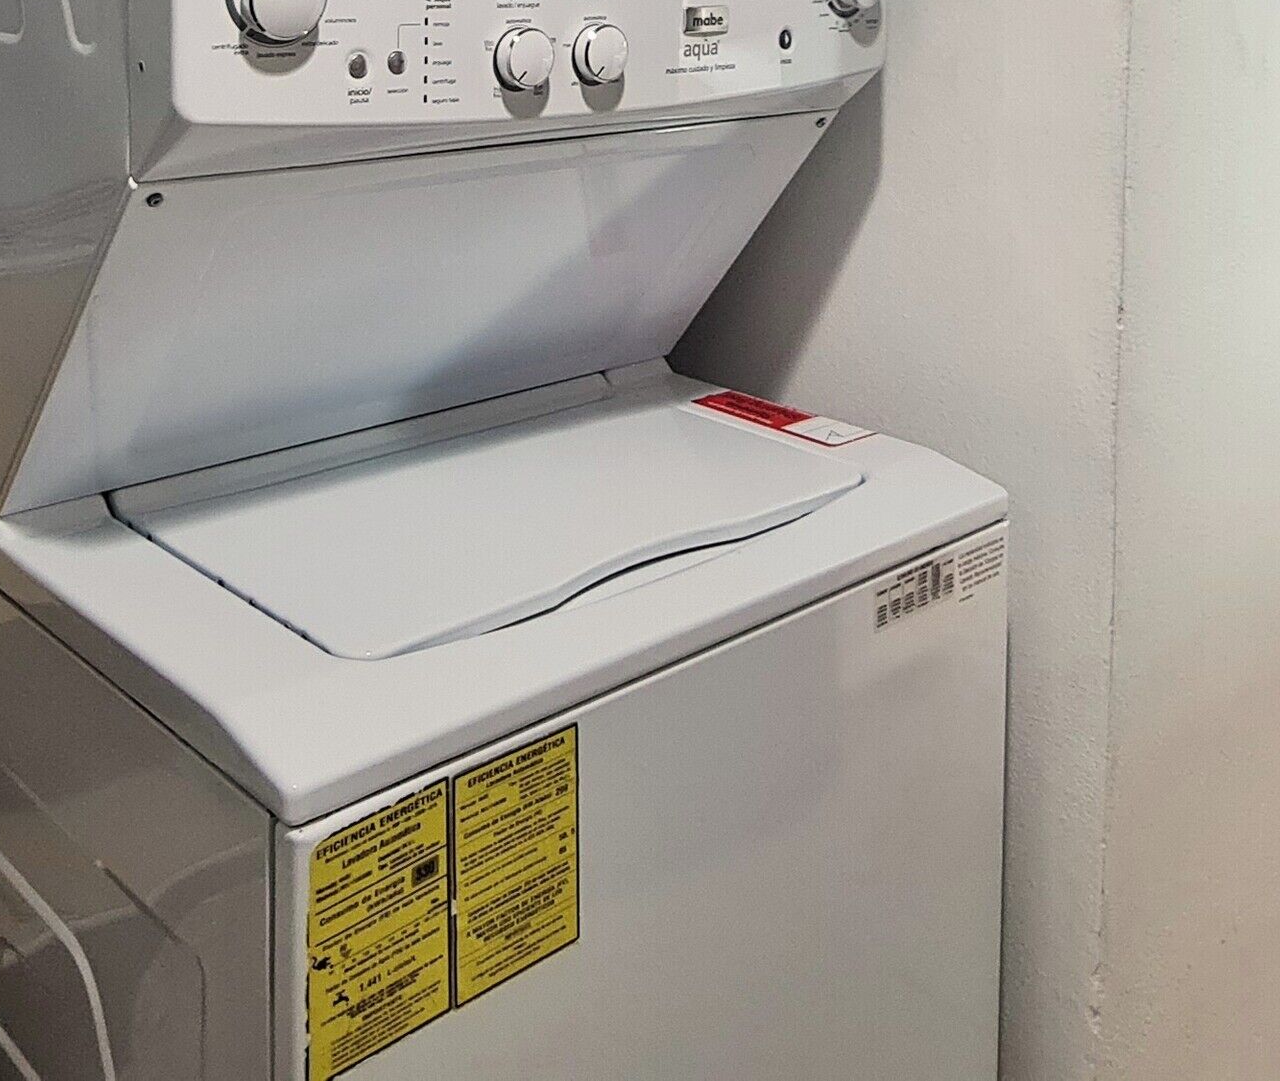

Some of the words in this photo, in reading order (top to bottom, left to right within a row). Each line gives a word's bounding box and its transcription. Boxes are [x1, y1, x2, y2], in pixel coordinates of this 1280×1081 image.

[692, 12, 724, 27] mabe
[467, 760, 514, 789] EFICIENCIA
[516, 736, 565, 764] ENERGÉTICA
[316, 821, 377, 861] EFICIENCIA
[379, 788, 443, 828] ENERGÉTICA
